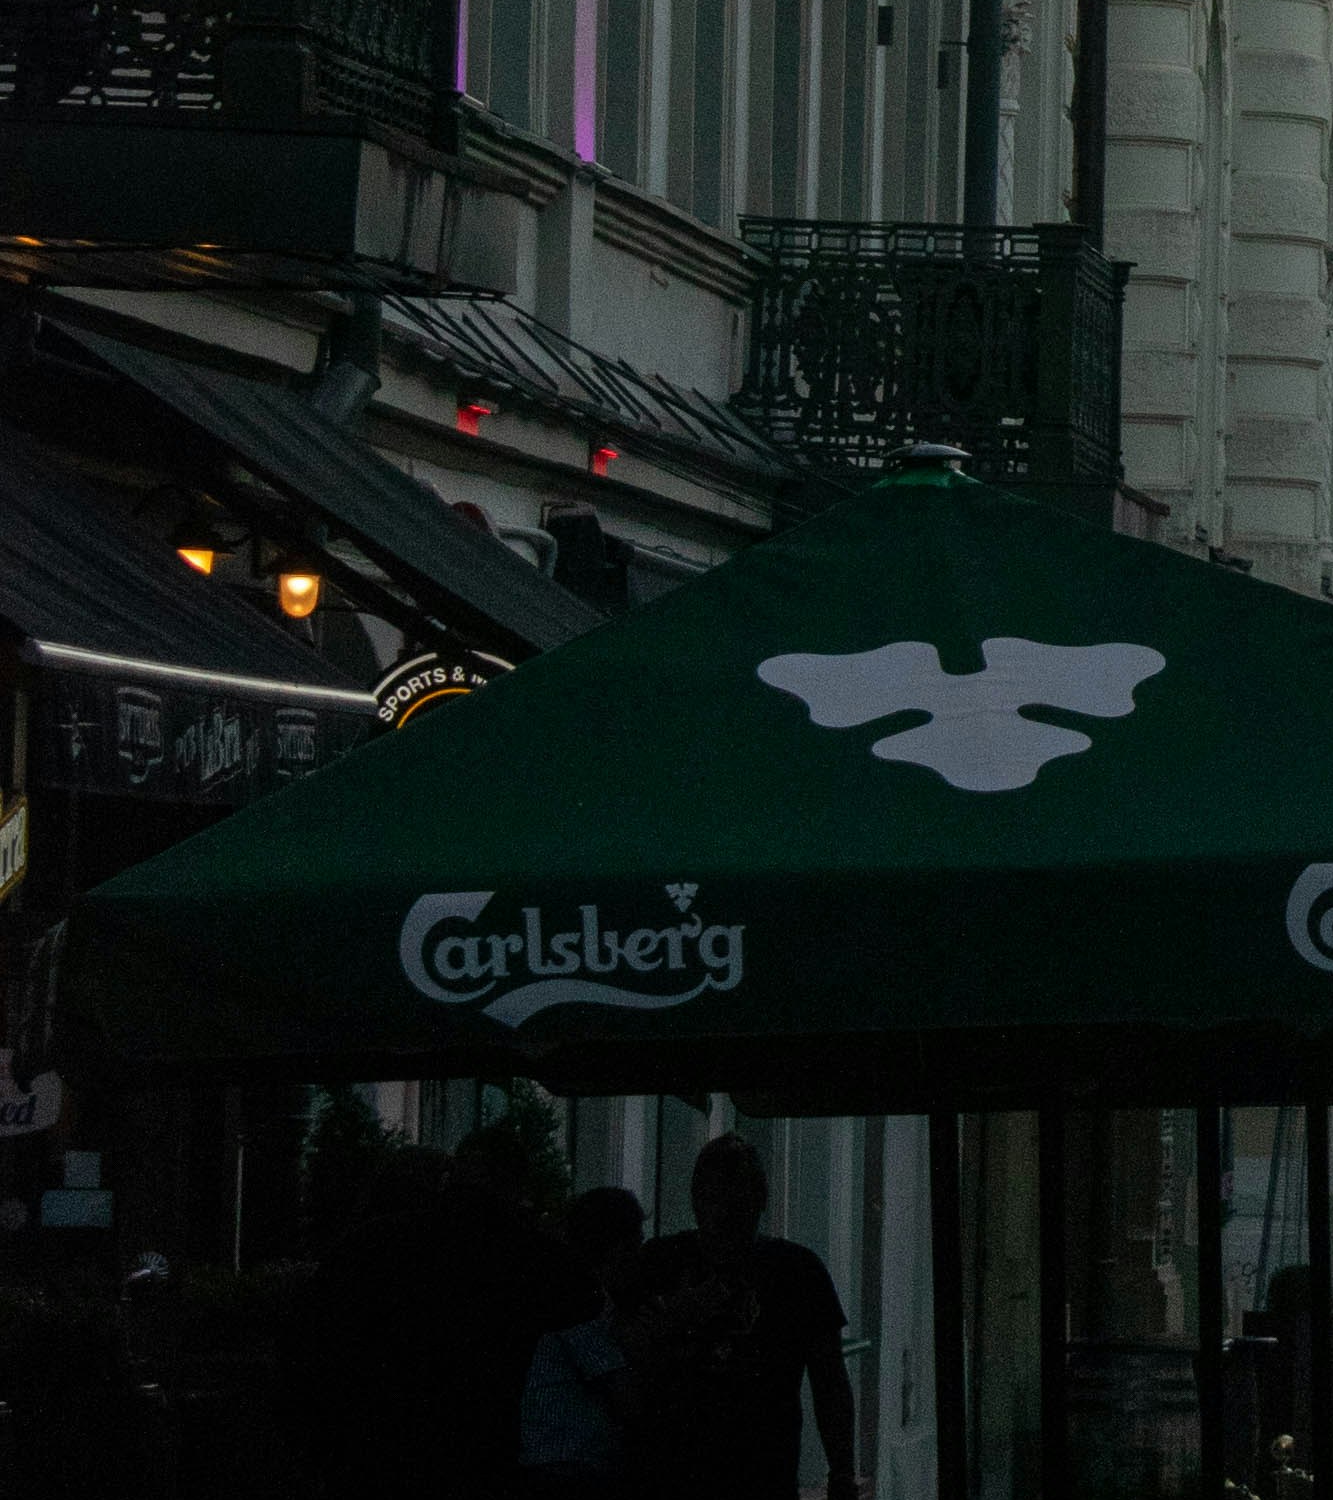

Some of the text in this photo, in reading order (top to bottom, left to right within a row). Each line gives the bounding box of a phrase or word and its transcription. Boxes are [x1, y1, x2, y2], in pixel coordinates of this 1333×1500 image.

[378, 665, 465, 722] SPORTS &
[400, 890, 745, 1028] Carlsberg
